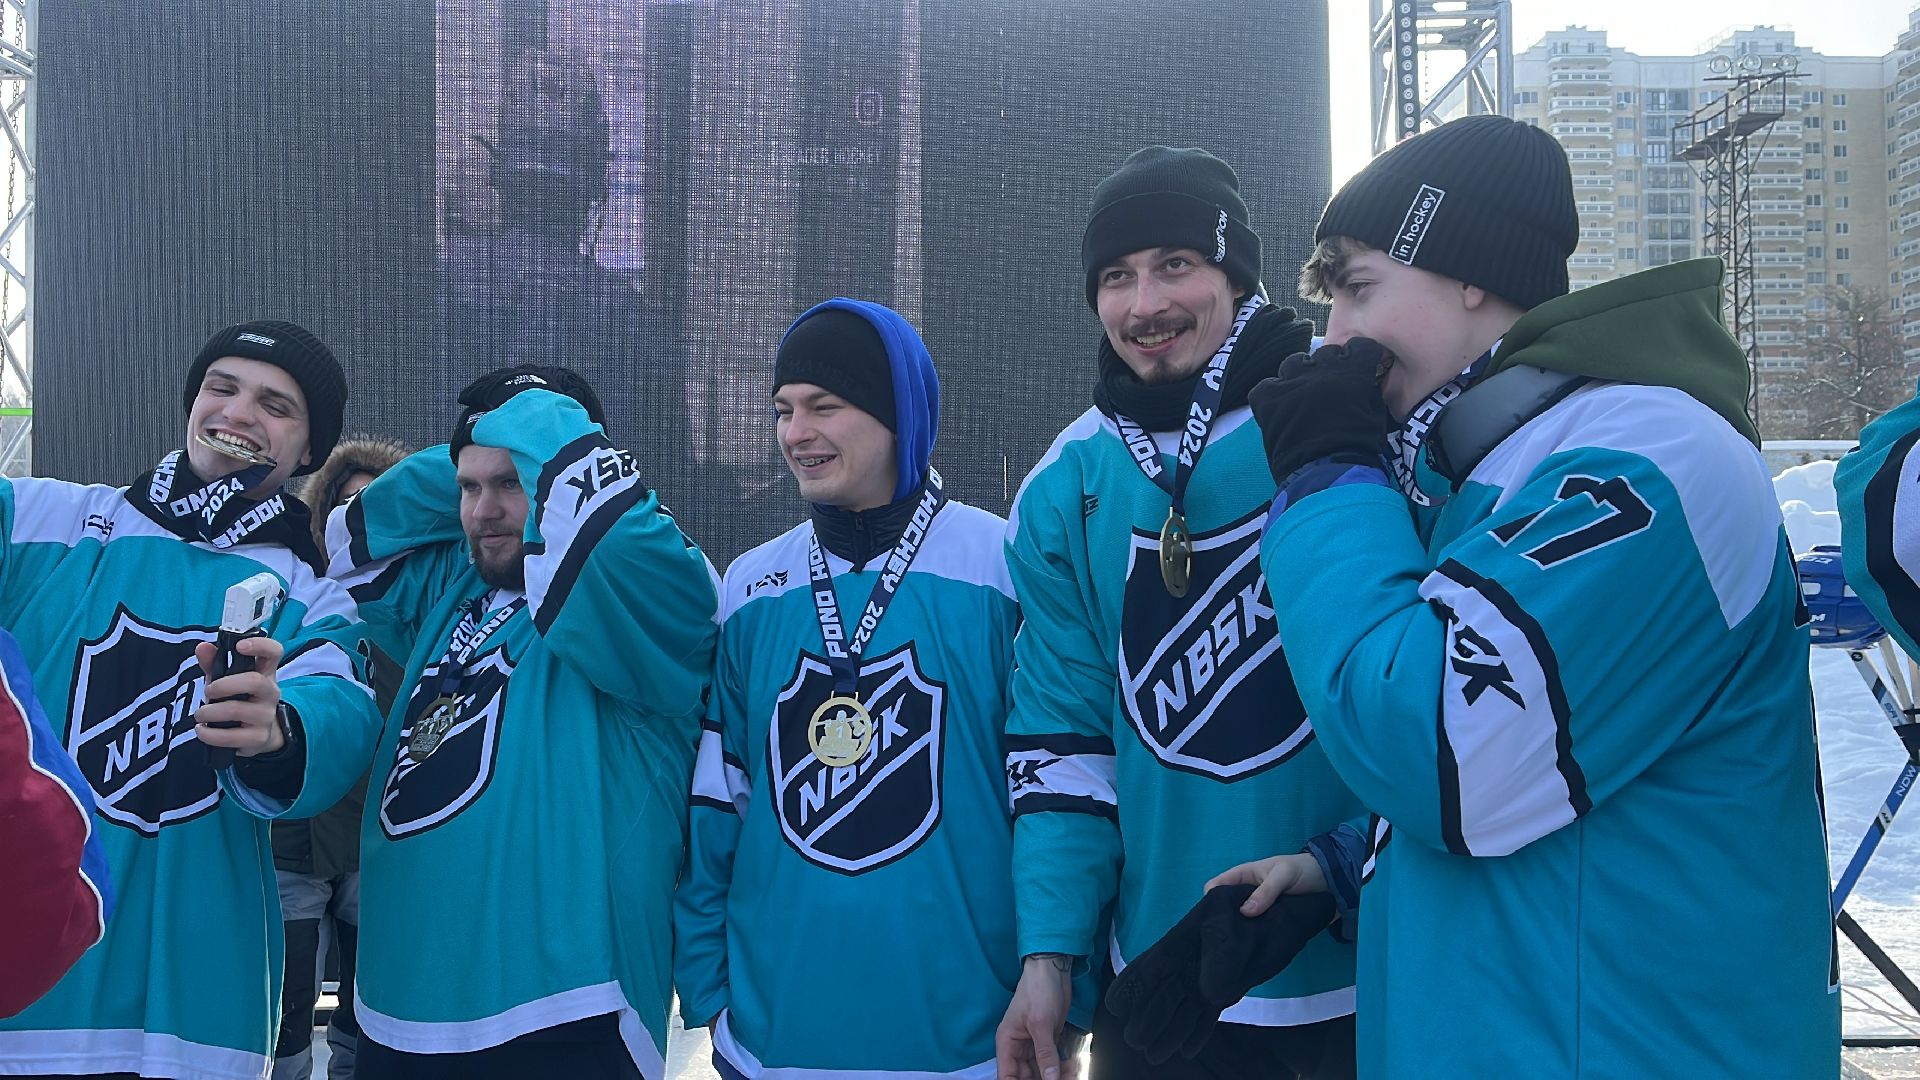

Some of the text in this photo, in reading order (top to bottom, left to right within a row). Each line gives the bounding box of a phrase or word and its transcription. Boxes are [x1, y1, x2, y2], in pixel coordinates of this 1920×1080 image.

[1395, 192, 1437, 257] in hockey
[1178, 402, 1212, 468] 2024
[202, 477, 245, 526] 2024
[851, 489, 938, 655] HOCKEY 2024
[457, 606, 514, 665] POND
[815, 590, 849, 659] POND
[1152, 573, 1276, 732] NBSK
